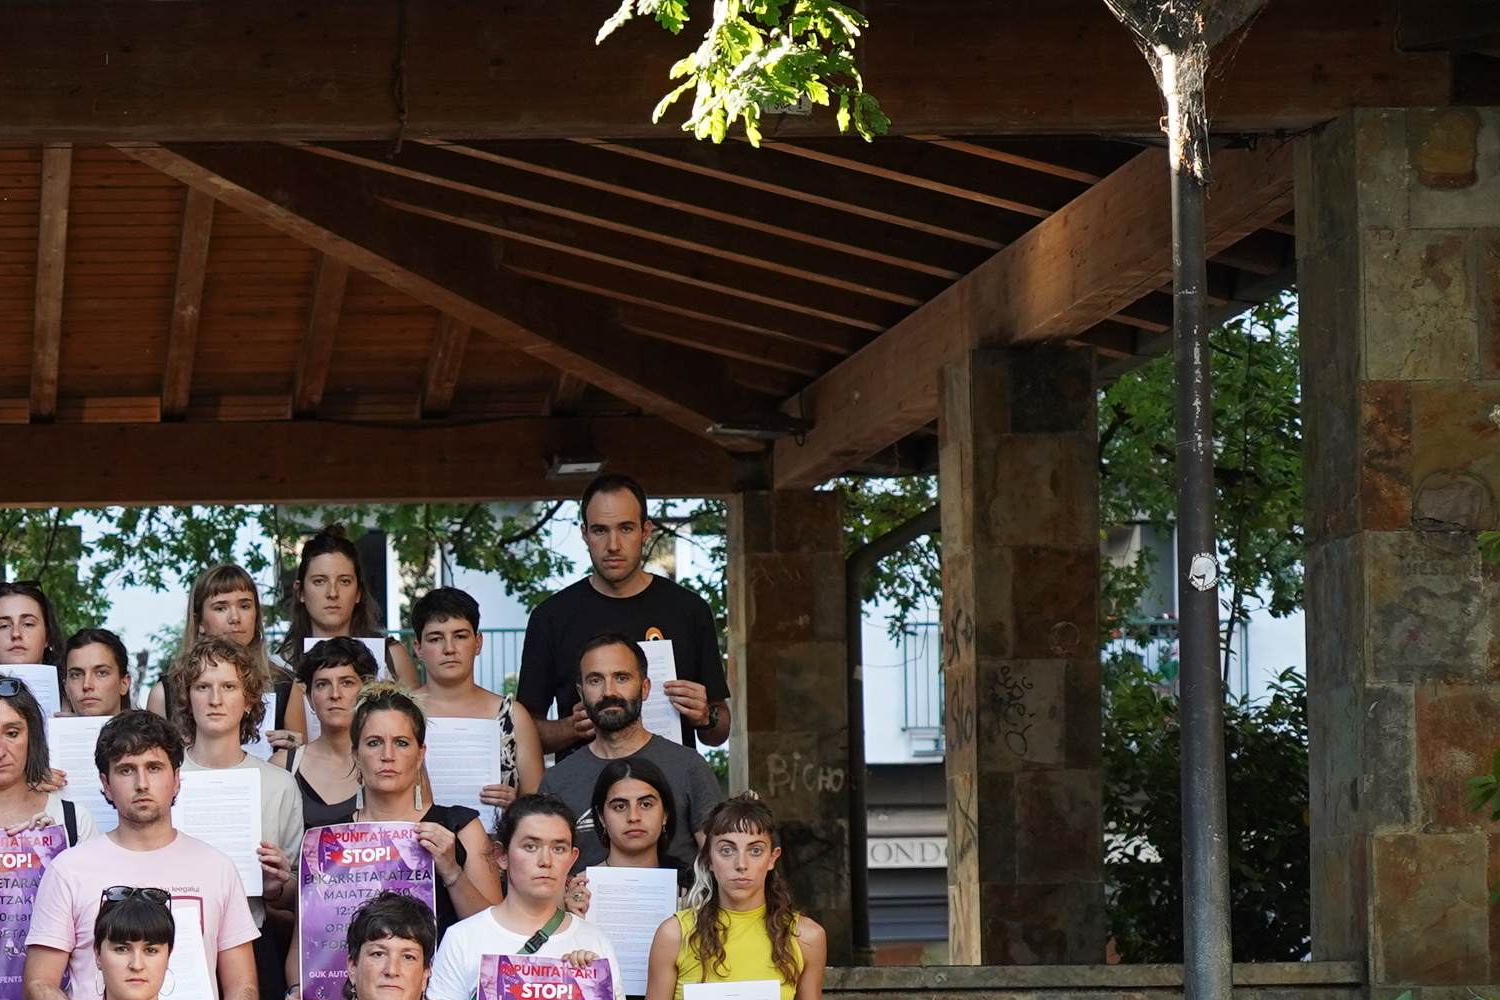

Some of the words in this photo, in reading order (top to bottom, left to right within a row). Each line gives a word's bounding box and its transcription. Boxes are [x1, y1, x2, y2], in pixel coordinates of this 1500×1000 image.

[342, 847, 391, 864] STOP!
[870, 841, 948, 864] OND
[304, 870, 432, 885] ELKARRETARATZEA
[309, 971, 326, 979] GUK
[521, 983, 573, 999] STOP!
